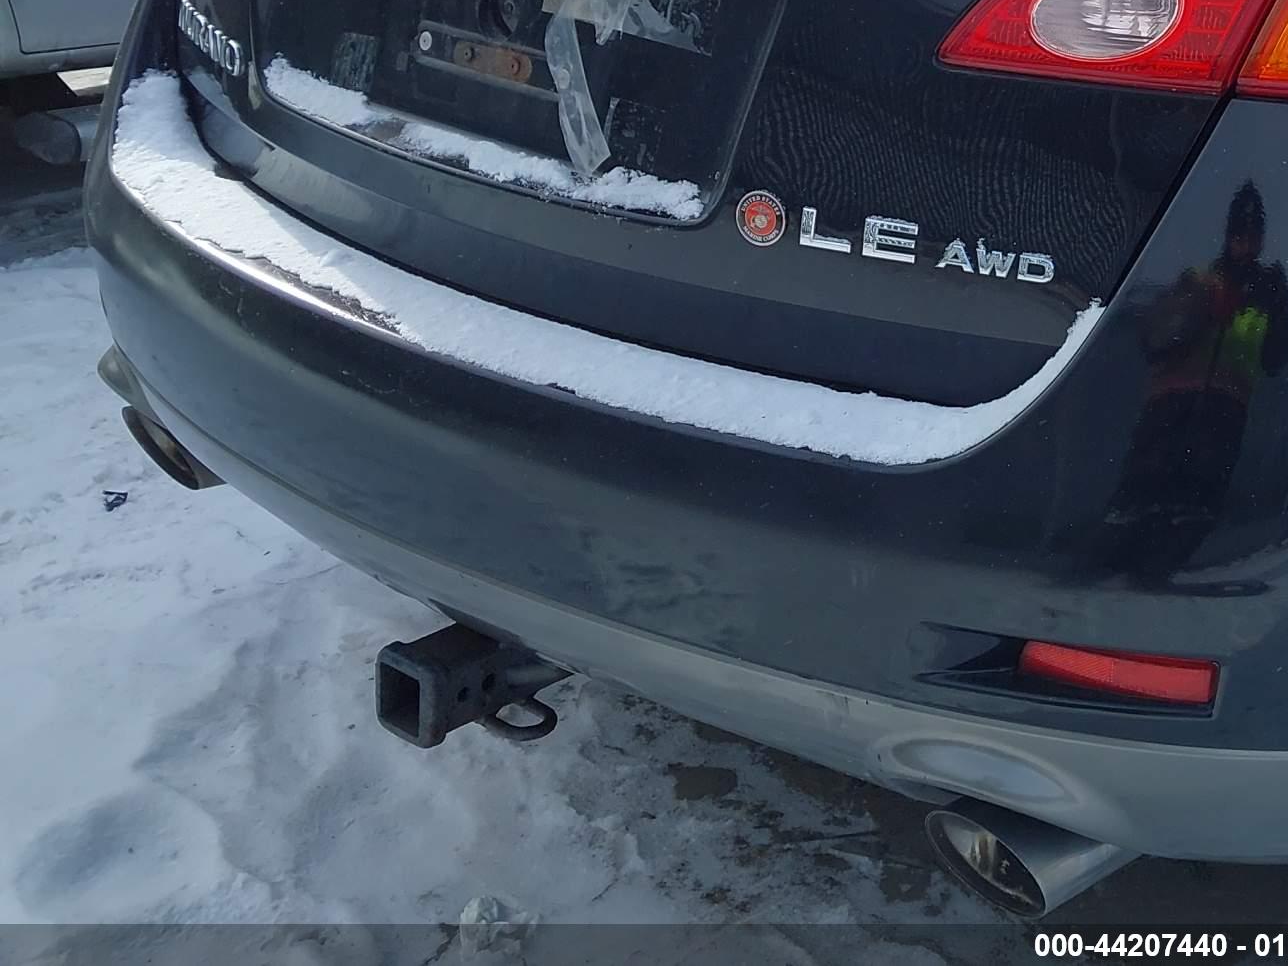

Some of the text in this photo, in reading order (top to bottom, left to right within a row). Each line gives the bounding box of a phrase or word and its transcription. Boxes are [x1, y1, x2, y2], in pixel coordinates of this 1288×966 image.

[741, 195, 781, 215] UNITED STATES
[743, 225, 779, 242] MARINE CORPS
[799, 206, 1056, 284] LE AWD
